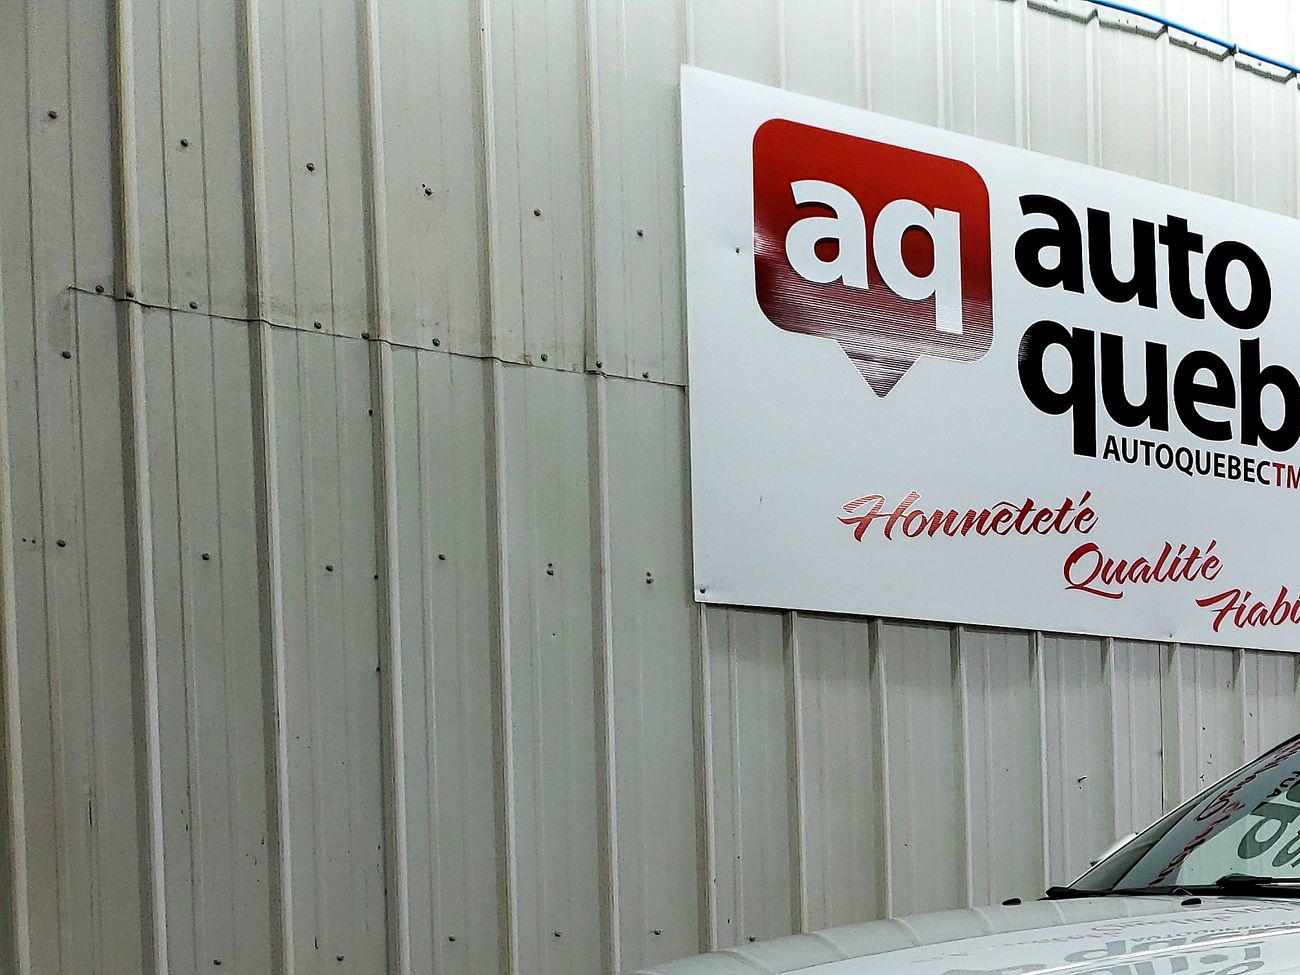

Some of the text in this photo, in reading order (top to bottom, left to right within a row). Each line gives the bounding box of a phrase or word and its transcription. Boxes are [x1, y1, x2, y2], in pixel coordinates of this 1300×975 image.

[785, 179, 963, 335] aq
[1014, 194, 1272, 330] auto
[838, 490, 1098, 542] Honnêteté
[1063, 540, 1223, 600] Qualité
